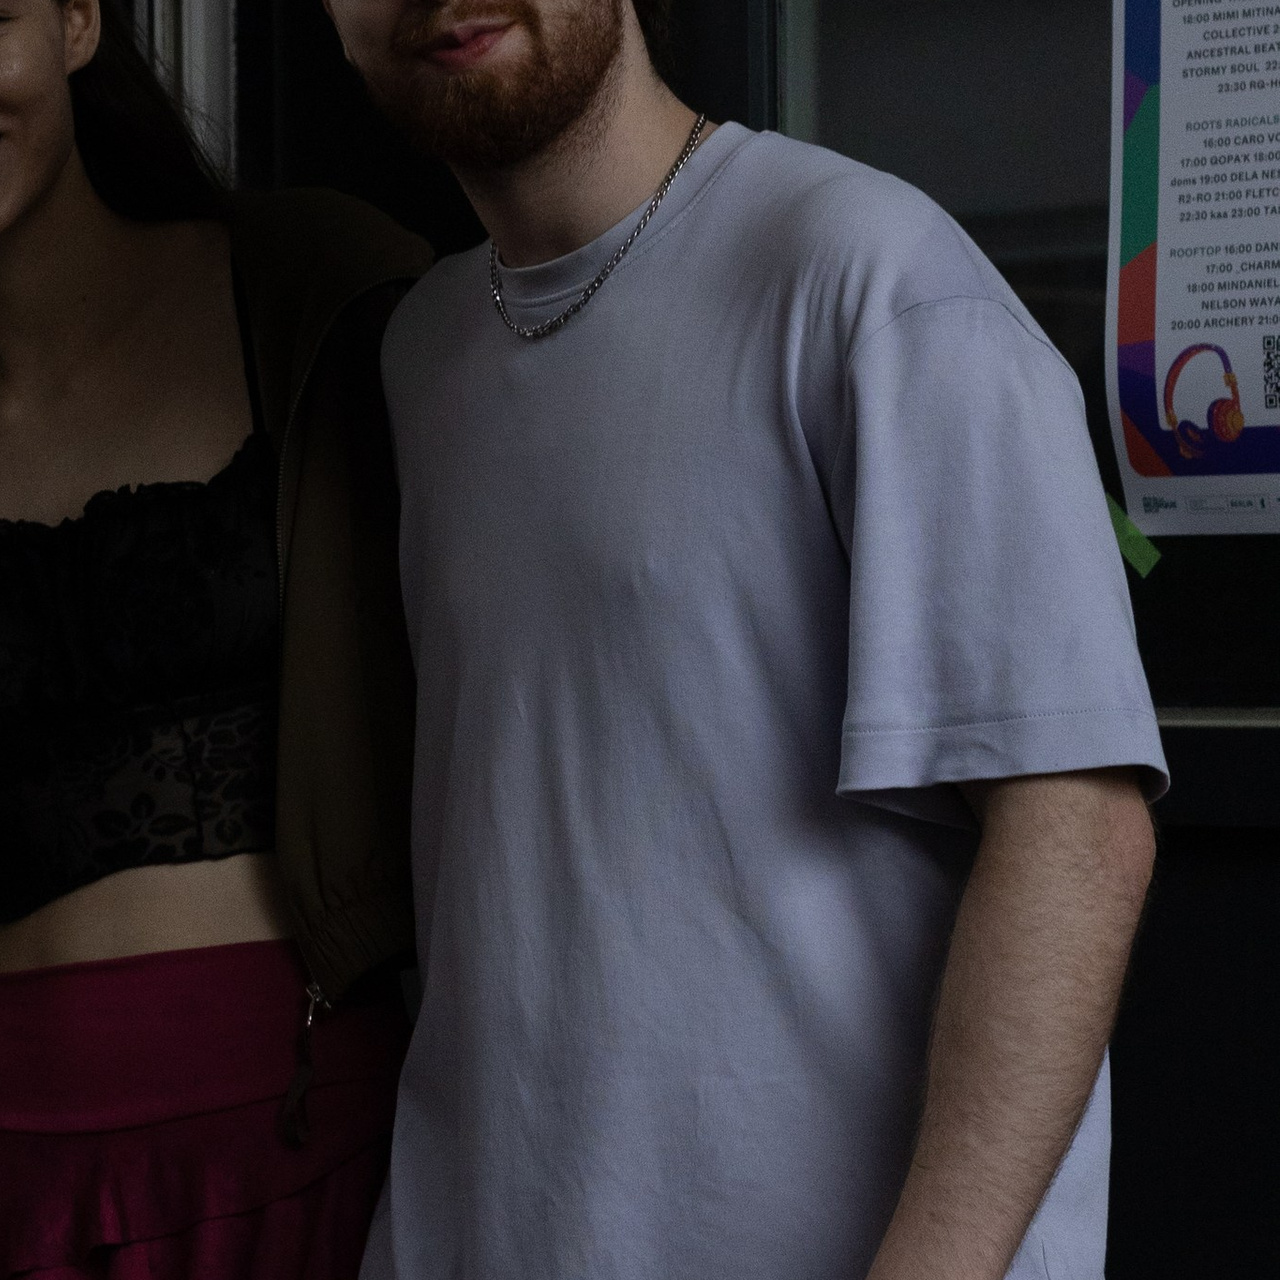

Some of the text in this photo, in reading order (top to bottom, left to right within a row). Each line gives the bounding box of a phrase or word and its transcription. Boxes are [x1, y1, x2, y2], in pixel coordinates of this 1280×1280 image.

[1182, 12, 1210, 24] 18:00
[1213, 10, 1239, 20] MIMI
[1203, 24, 1270, 40] COLLECTIVE
[1186, 45, 1251, 60] ANCESTRAL
[1182, 65, 1227, 79] STORMY
[1230, 62, 1259, 74] SOUL
[1217, 81, 1246, 93] 23:30
[1185, 114, 1280, 131] ROOTS RADICALS
[1203, 136, 1231, 148] 16:00
[1234, 133, 1265, 146] CARO
[1180, 156, 1207, 168] 17:00
[1200, 173, 1227, 185] 19:00
[1230, 171, 1258, 182] DELA
[1214, 189, 1242, 202] 21:00
[1179, 210, 1207, 222] 22:30
[1231, 206, 1260, 219] 23:00
[1169, 245, 1221, 258] ROOFTOP
[1224, 243, 1252, 255] 16:00
[1206, 262, 1233, 274] 17:00
[1187, 282, 1215, 293] 18:00
[1201, 298, 1246, 310] NELSON
[1171, 313, 1280, 331] 20:00 ARCHERY 21:0
